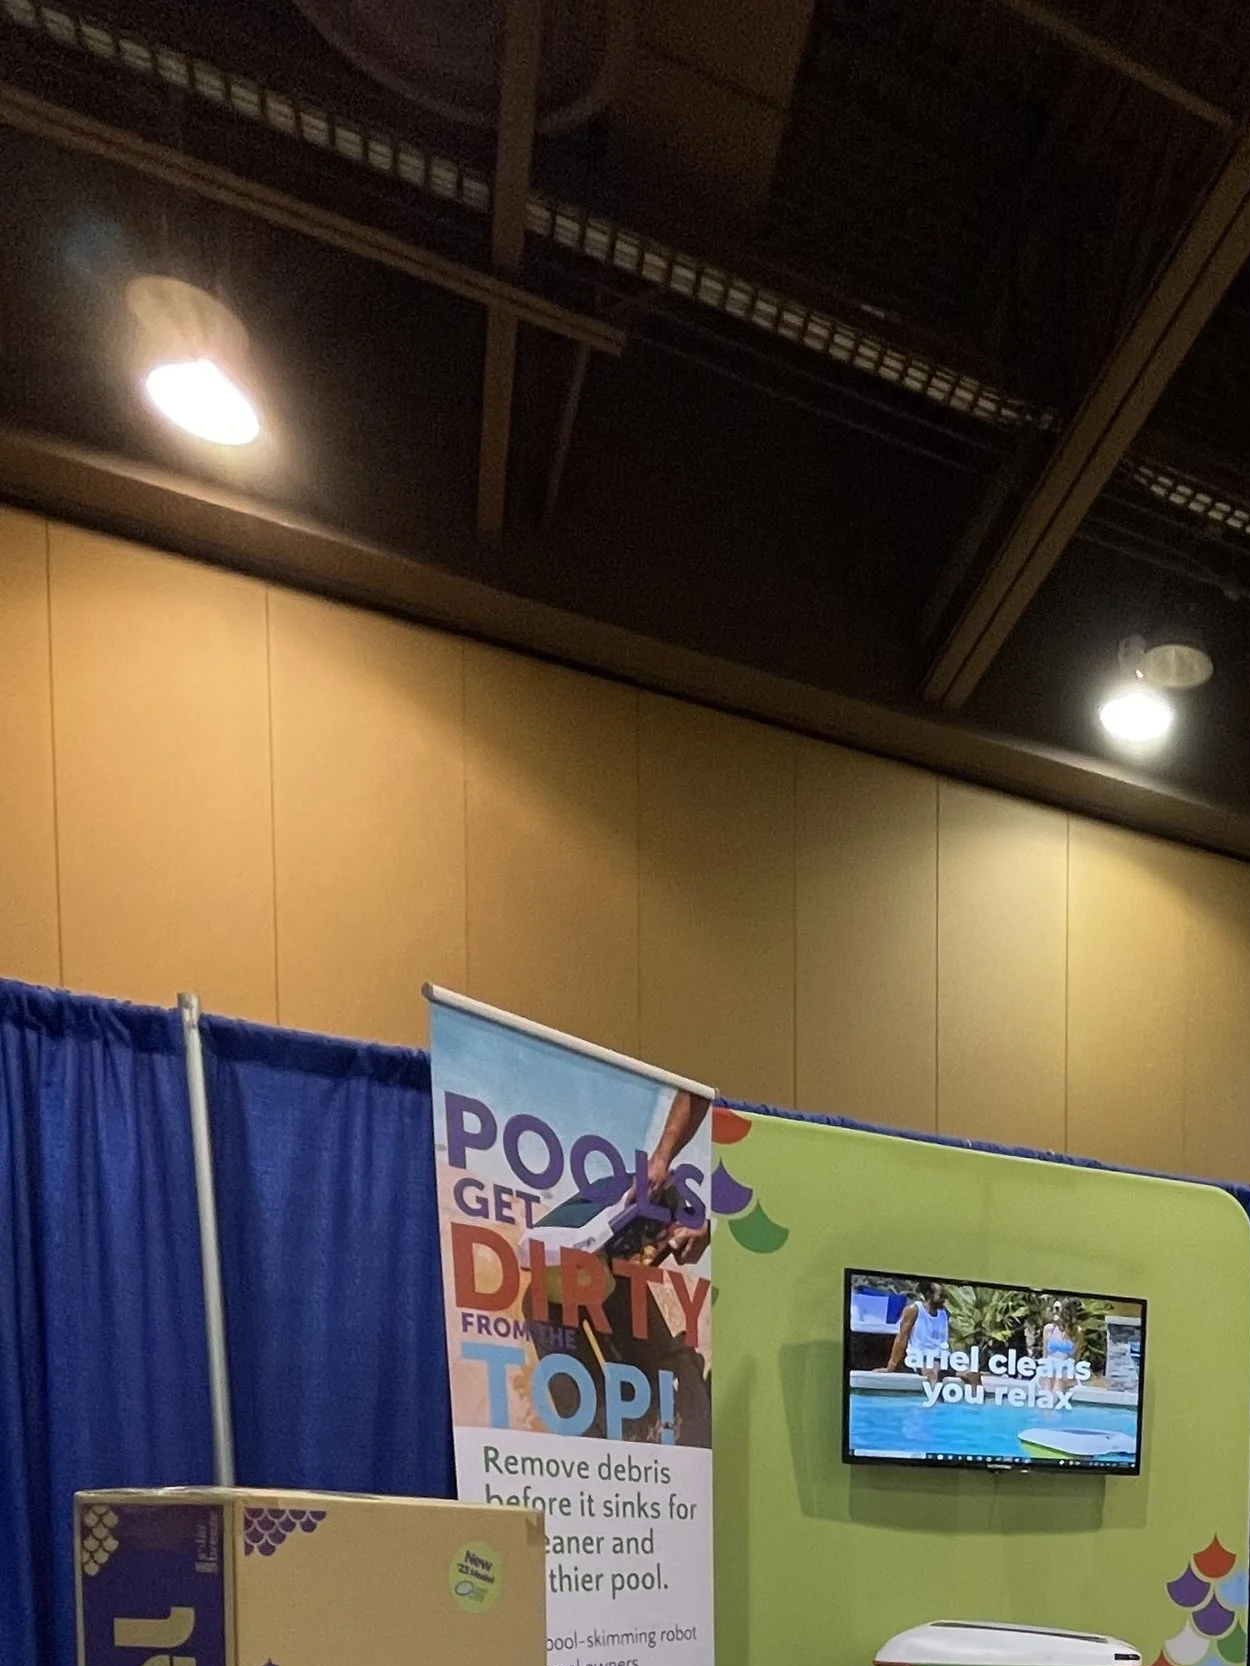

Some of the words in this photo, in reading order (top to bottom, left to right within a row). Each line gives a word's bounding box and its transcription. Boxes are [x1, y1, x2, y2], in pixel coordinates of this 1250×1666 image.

[444, 1090, 706, 1228] POOLS
[454, 1178, 541, 1229] GET
[450, 1223, 712, 1349] DIRTY
[461, 1312, 531, 1341] FROM
[536, 1322, 577, 1351] THE
[904, 1343, 979, 1374] ariel
[988, 1348, 1092, 1382] cleans
[460, 1342, 676, 1446] TOP!
[922, 1380, 985, 1409] you
[994, 1378, 1073, 1411] relax
[484, 1446, 590, 1479] Remove
[598, 1453, 671, 1484] debris
[579, 1491, 596, 1517] it
[603, 1491, 661, 1520] sinks
[668, 1493, 698, 1520] for
[545, 1535, 605, 1555] aner
[612, 1528, 655, 1554] and
[464, 1550, 493, 1572] New
[548, 1564, 603, 1593] thier
[611, 1563, 668, 1600] pool.
[660, 1624, 697, 1642] robot
